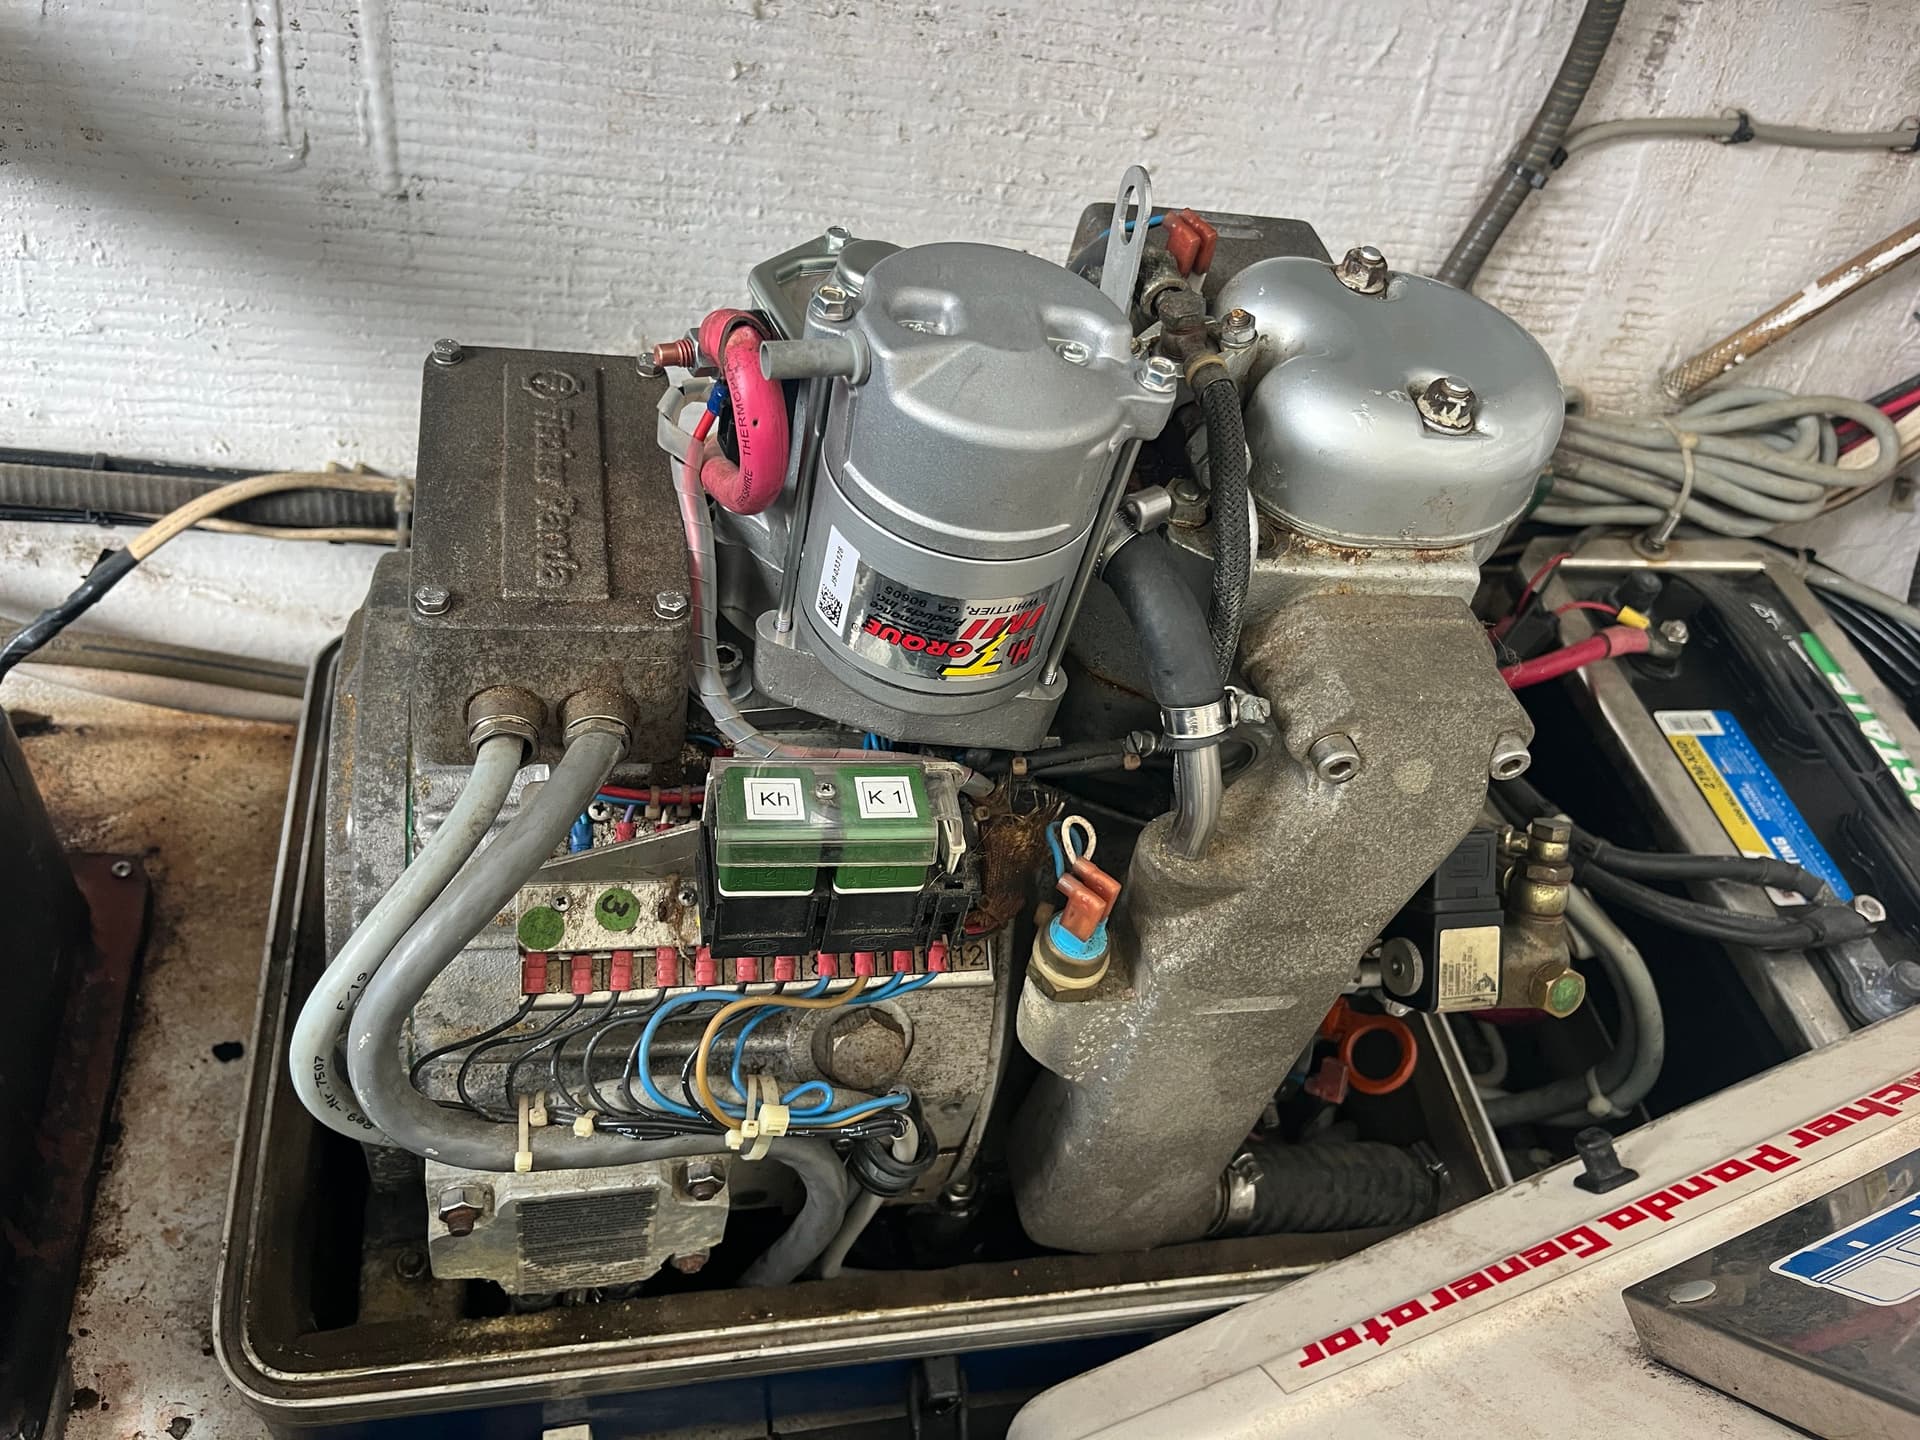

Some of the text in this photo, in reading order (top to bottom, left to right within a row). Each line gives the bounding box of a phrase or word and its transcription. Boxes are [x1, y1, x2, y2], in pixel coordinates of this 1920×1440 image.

[937, 603, 960, 615] CA
[965, 598, 1039, 616] WHITTIER,
[862, 615, 1003, 677] TORQUE
[759, 791, 791, 808] Kh
[867, 789, 902, 805] K 1
[956, 944, 984, 967] 12
[1298, 1070, 1920, 1368] cher Panda Generator
